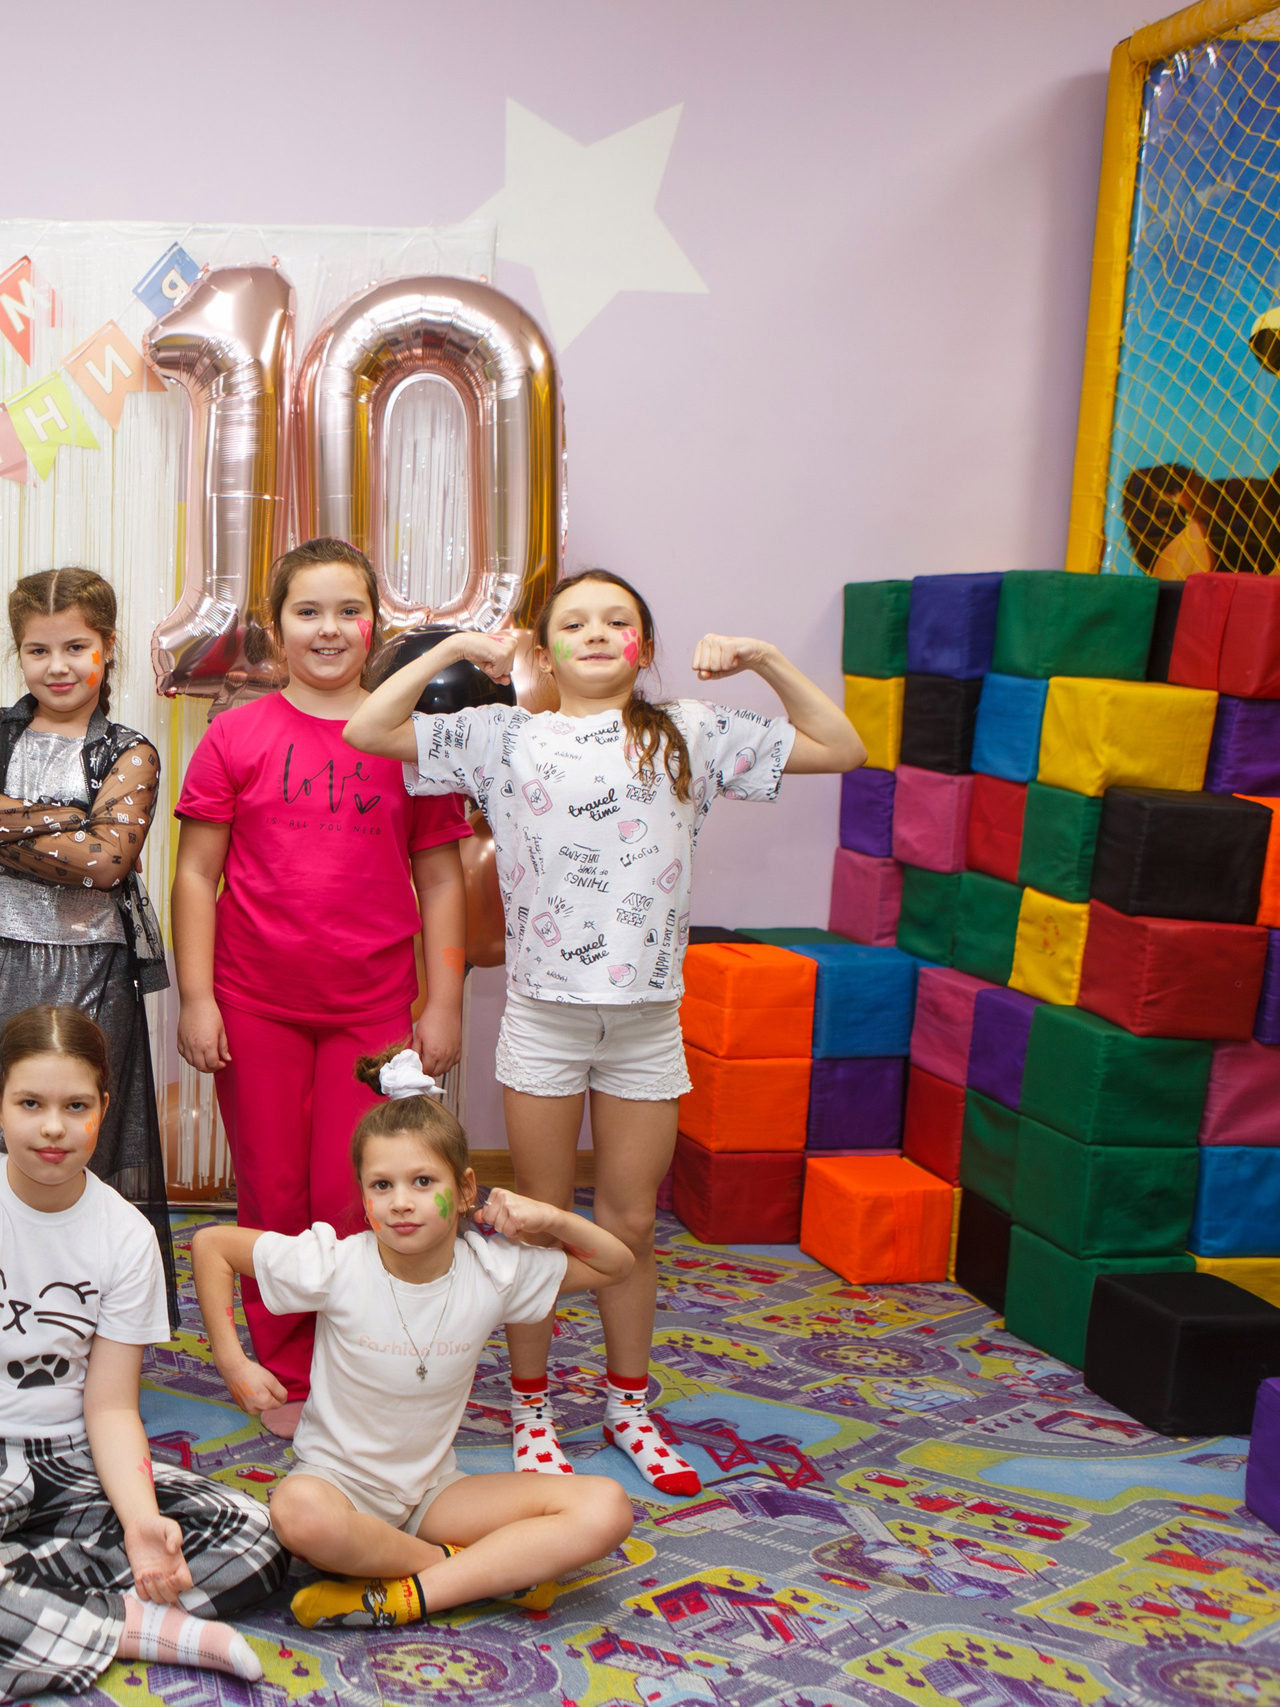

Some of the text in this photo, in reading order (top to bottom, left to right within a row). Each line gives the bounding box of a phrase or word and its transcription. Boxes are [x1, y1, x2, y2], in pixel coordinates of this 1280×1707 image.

[143, 262, 568, 698] 10
[428, 717, 445, 760] THINGS
[575, 720, 620, 745] travel
[595, 735, 620, 745] time
[770, 740, 783, 770] Enjoy
[283, 743, 370, 813] love
[568, 788, 618, 817] travel
[626, 784, 657, 804] FEEL
[589, 805, 621, 821] time
[266, 816, 381, 835] IS ALL YOU NEED
[558, 846, 601, 863] DREAMS
[632, 845, 660, 861] Enjoy
[578, 864, 598, 875] YOUR
[564, 872, 610, 893] THINGS
[622, 892, 654, 911] DAY
[616, 908, 646, 928] FEEL
[560, 933, 607, 961] travel
[662, 929, 674, 947] STAY
[580, 950, 609, 966] time
[652, 949, 671, 978] HAPPY
[648, 977, 664, 989] BE
[359, 1333, 470, 1357] Fashion Diva
